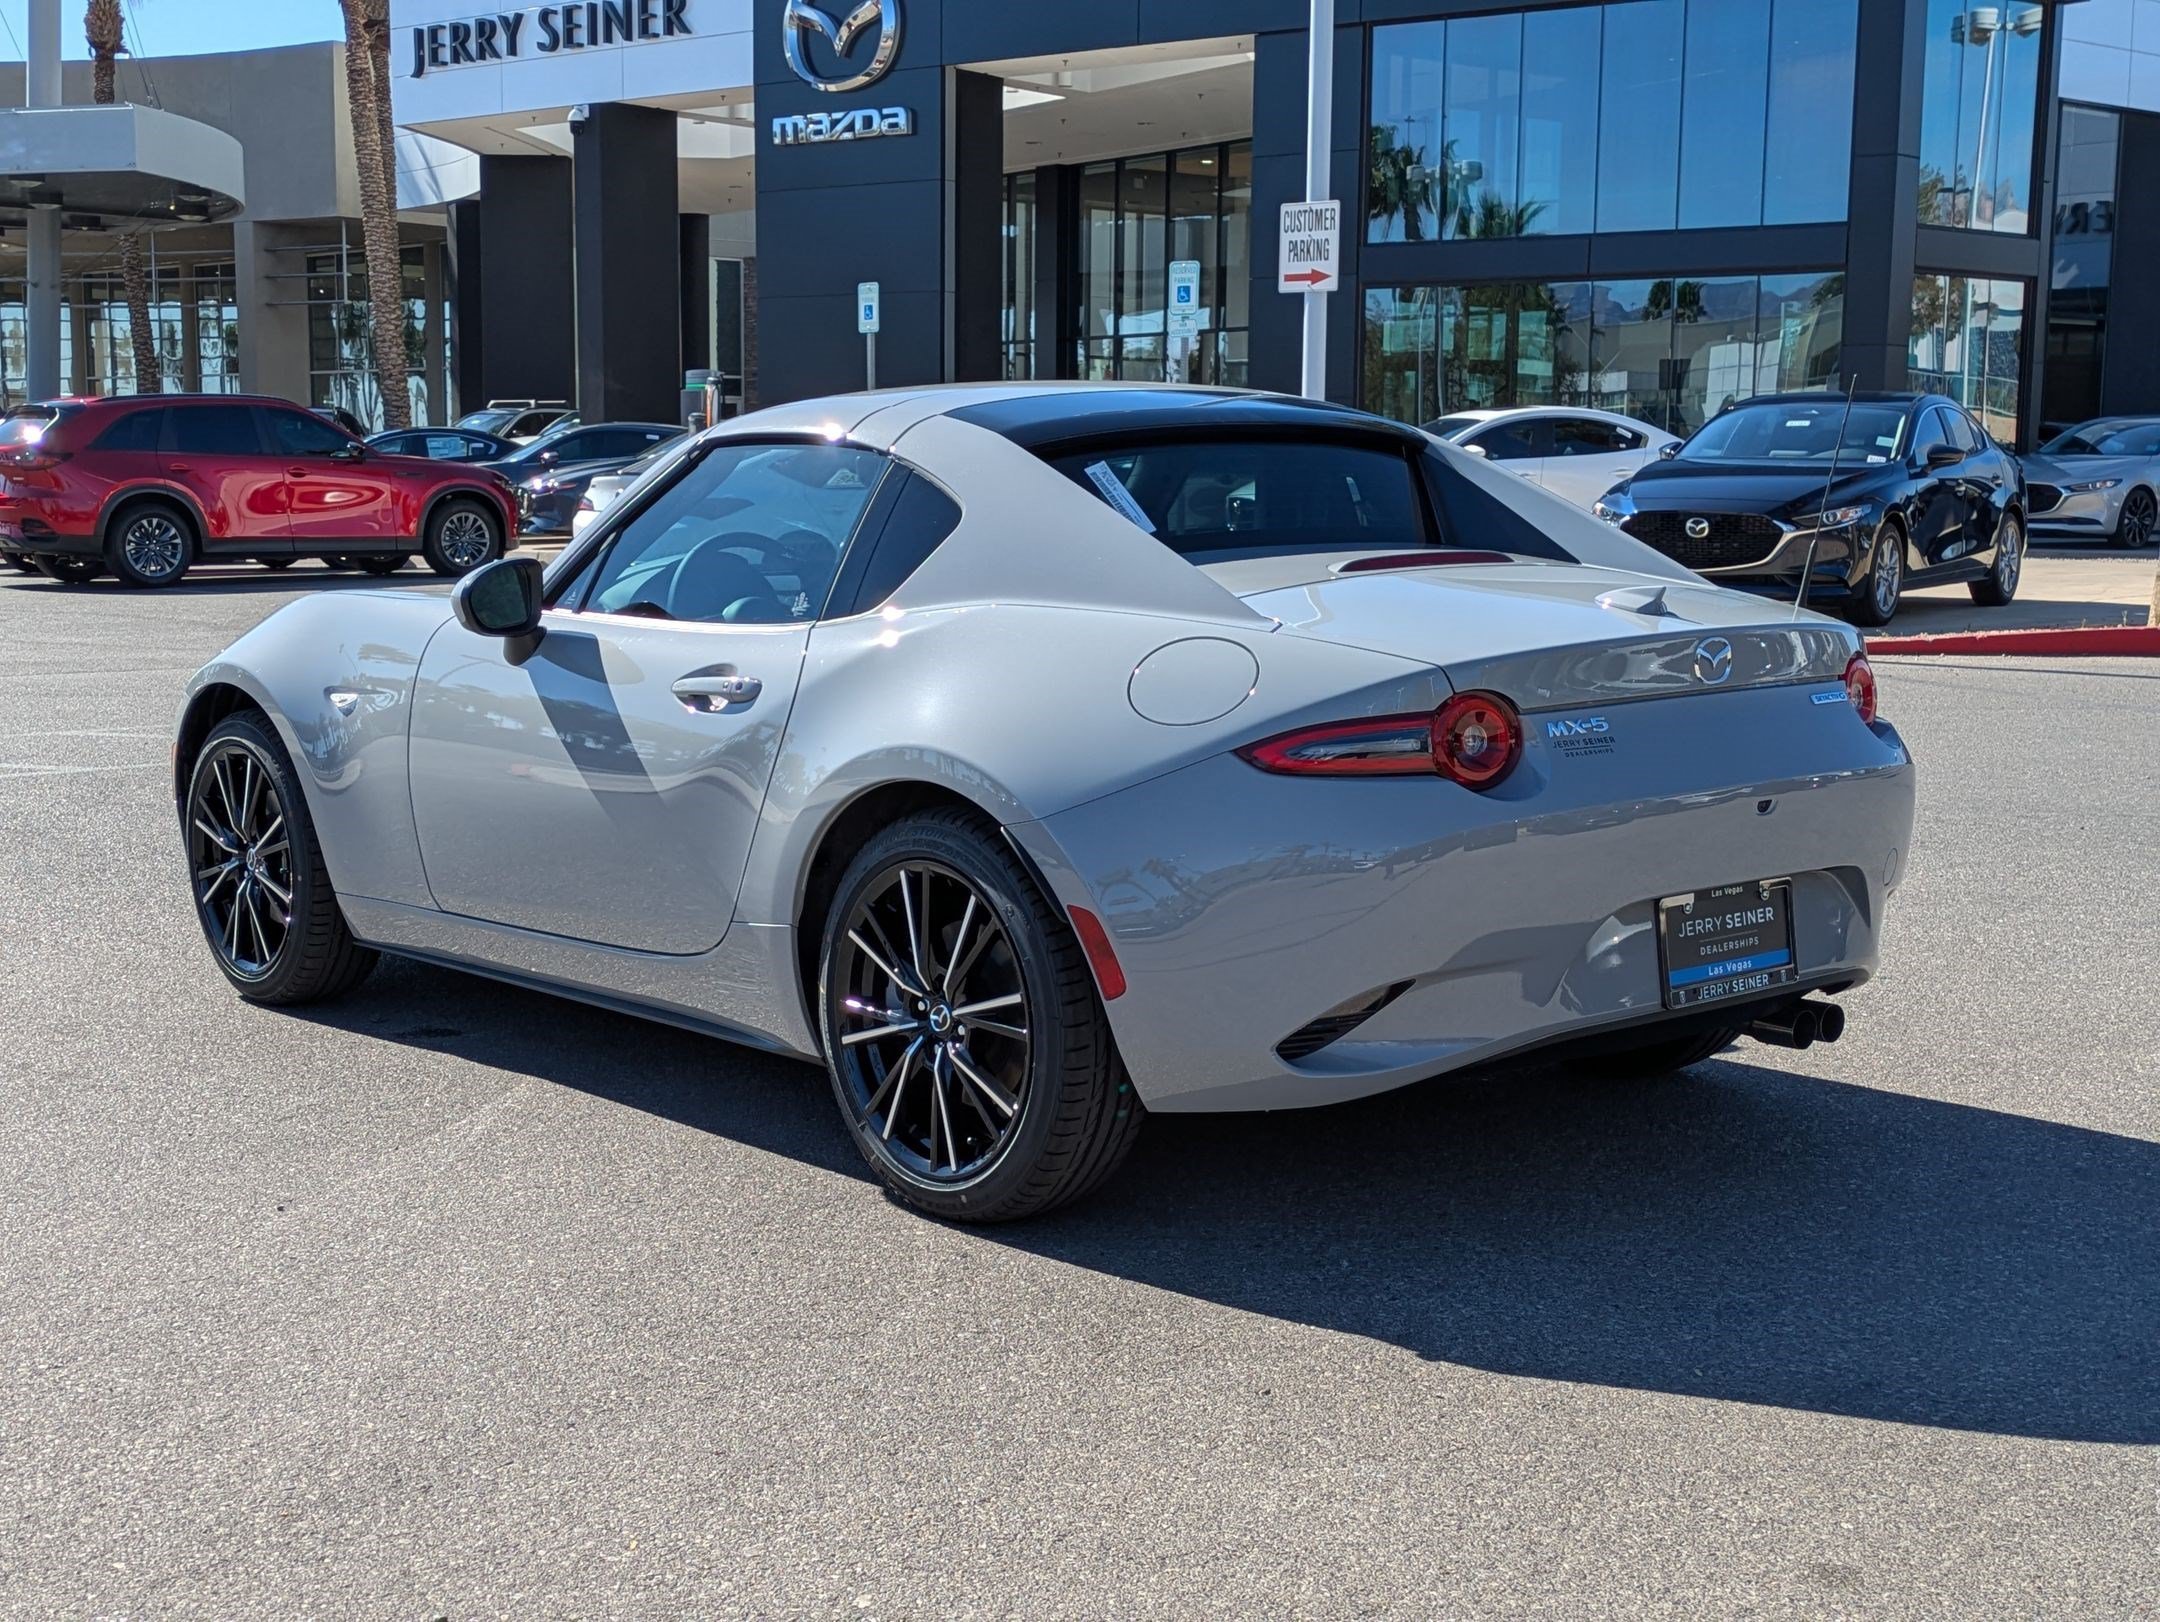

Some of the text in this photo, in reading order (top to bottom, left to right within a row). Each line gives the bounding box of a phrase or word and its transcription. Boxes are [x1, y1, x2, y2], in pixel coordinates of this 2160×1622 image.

[410, 0, 693, 79] JERRY SEINER
[772, 106, 913, 146] mazda
[1283, 208, 1336, 234] CUSTOMER
[1288, 238, 1330, 263] PARKING
[1546, 716, 1609, 738] MX-5
[1553, 736, 1616, 749] JERRY SEINER
[1564, 747, 1614, 758] DEALERSHIPS
[1711, 885, 1743, 898] Las Vegas
[1678, 906, 1775, 938] JERRY SEINER
[1700, 936, 1759, 956] DEALERSHIPS
[1708, 959, 1752, 976] Las Vegas
[1698, 974, 1769, 1000] JERRY SEINER
